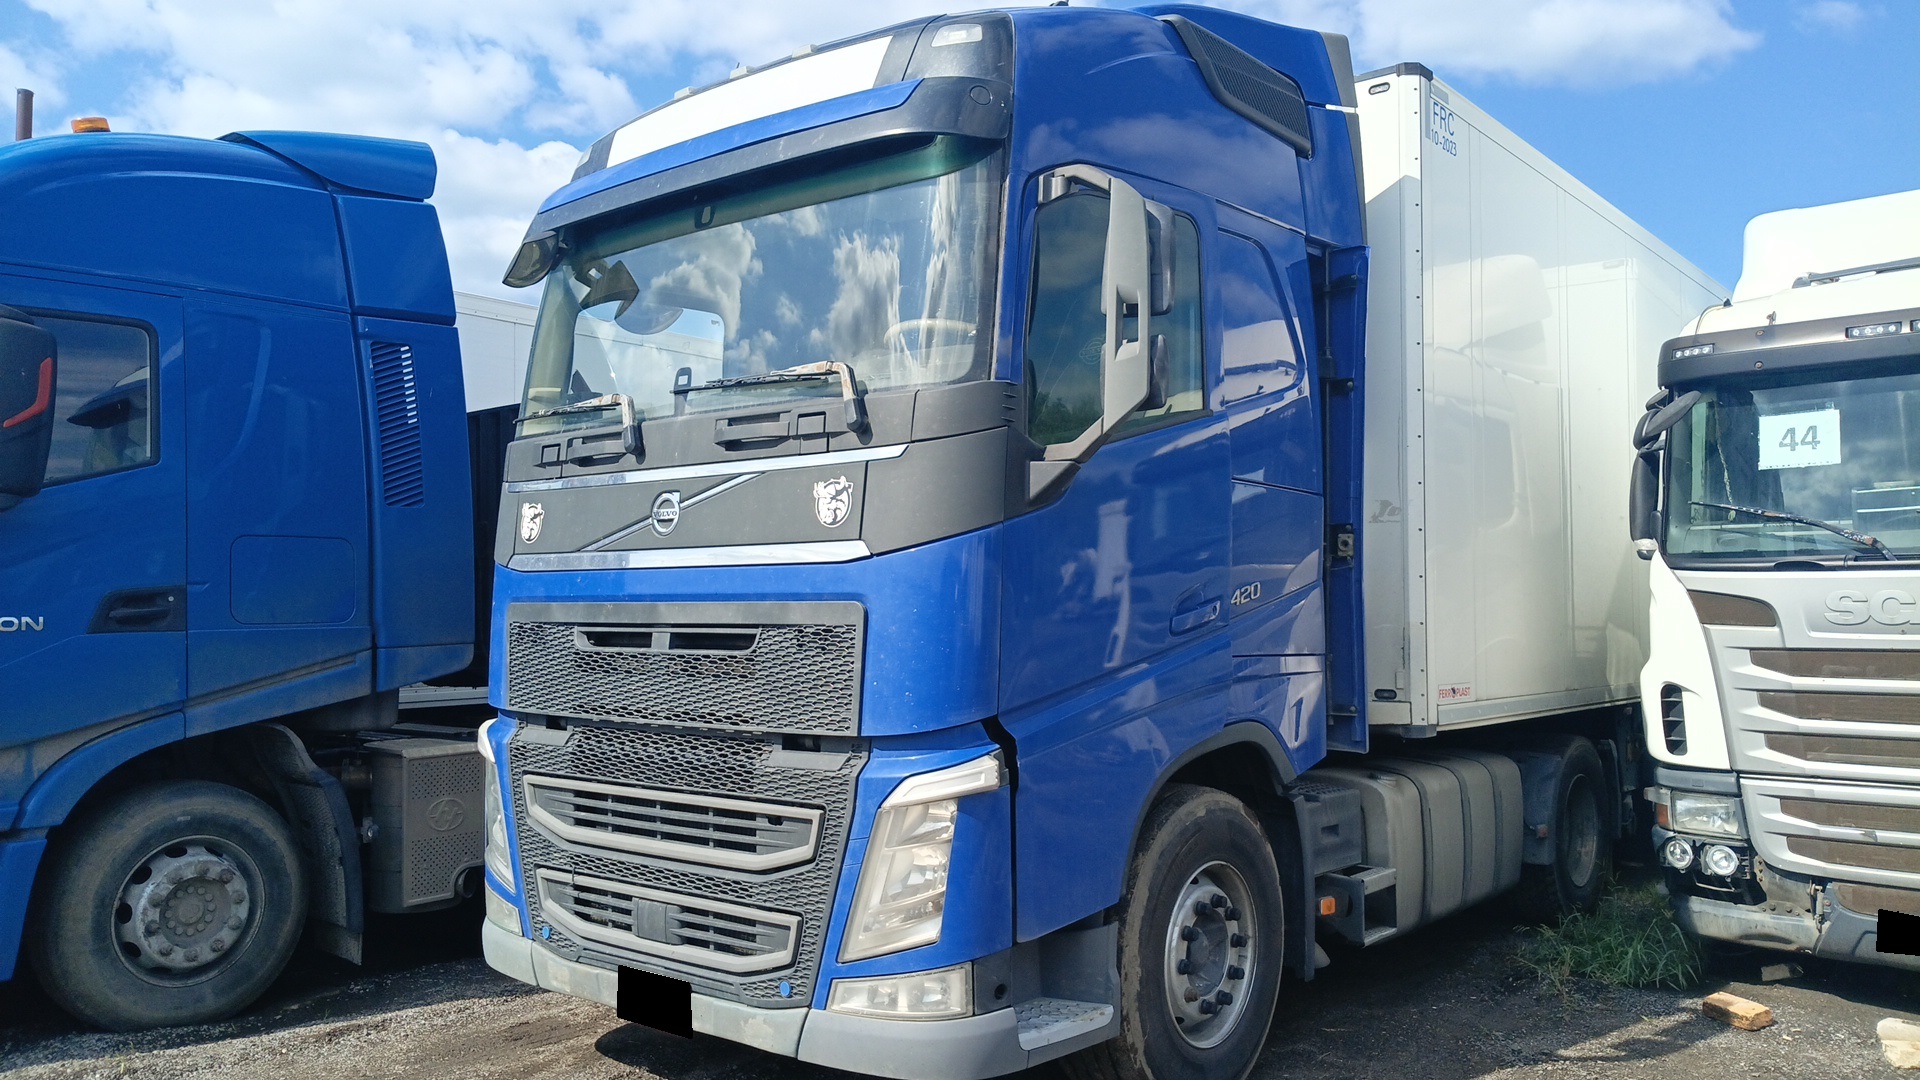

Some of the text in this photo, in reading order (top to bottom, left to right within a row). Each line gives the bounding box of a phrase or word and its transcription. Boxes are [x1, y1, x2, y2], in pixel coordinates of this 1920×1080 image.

[1433, 101, 1455, 136] FRC
[1431, 128, 1457, 157] 10-2023
[1779, 425, 1821, 451] 44
[653, 510, 677, 518] VOLVO
[1230, 581, 1260, 606] 420
[1824, 589, 1920, 626] SC
